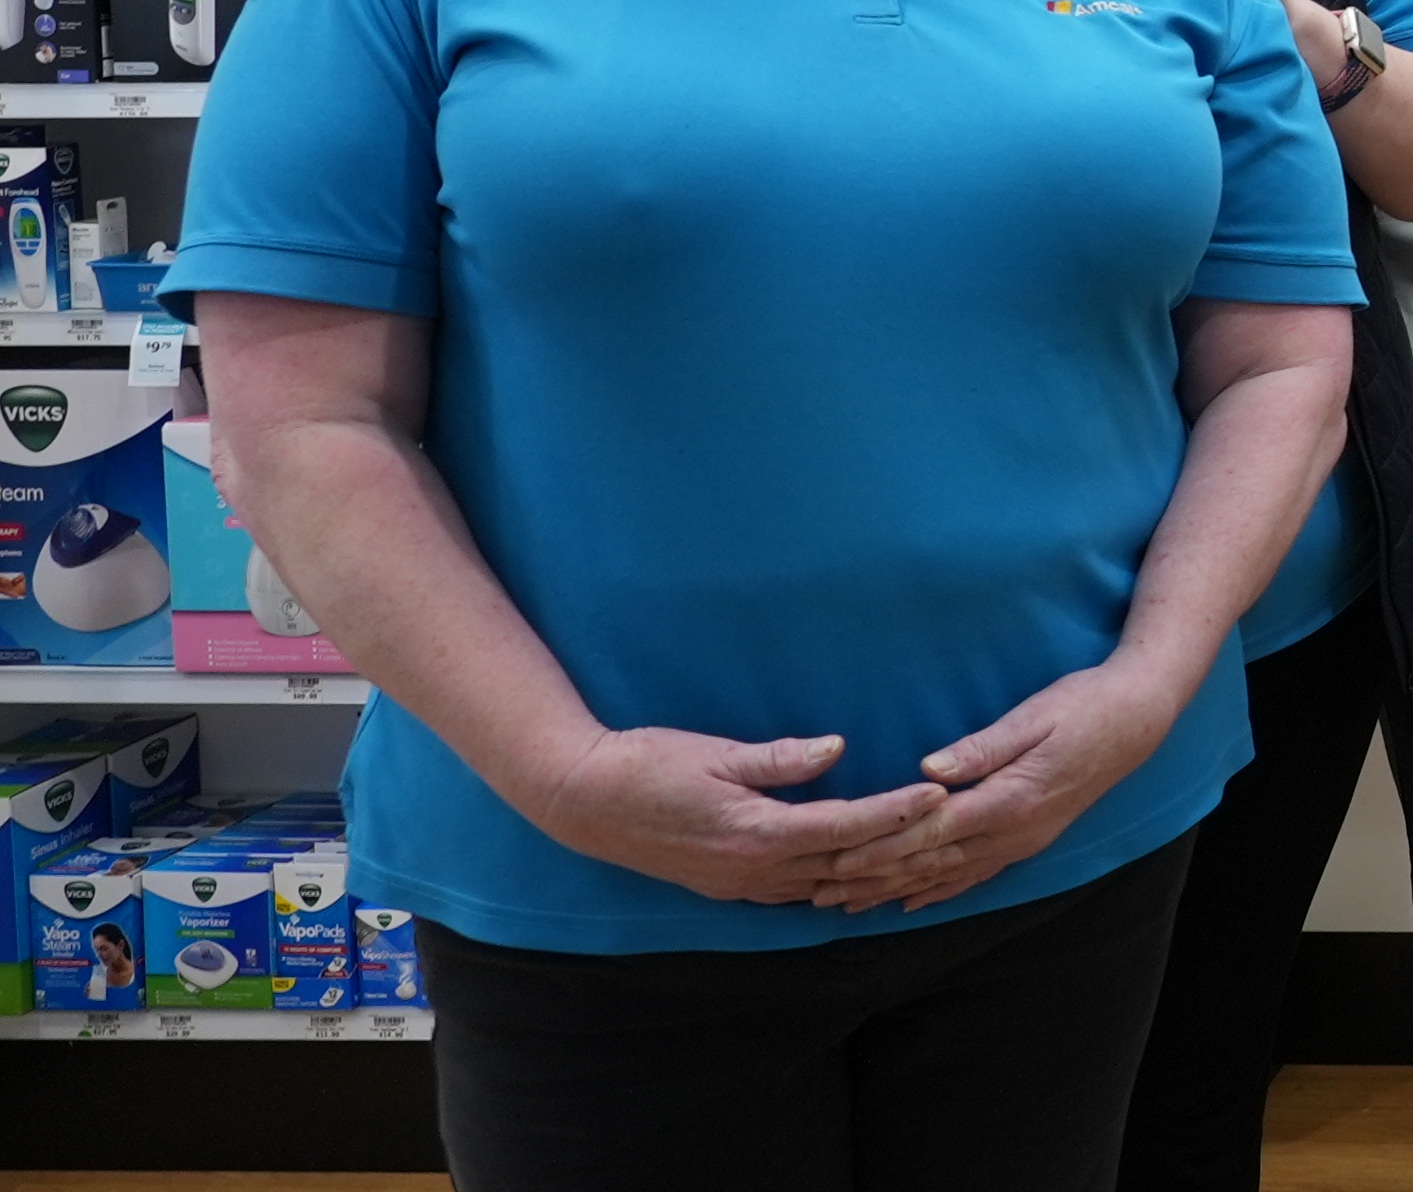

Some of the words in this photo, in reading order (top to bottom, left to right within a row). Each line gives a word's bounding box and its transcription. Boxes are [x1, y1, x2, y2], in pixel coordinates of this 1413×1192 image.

[4, 405, 65, 422] VICKS
[46, 791, 73, 810] VICKS
[31, 839, 58, 859] Sinus
[66, 889, 93, 899] VICKS
[179, 916, 230, 929] Vaporizer
[42, 925, 80, 942] Vapo
[279, 921, 346, 942] VapoPads
[42, 939, 81, 953] Steam
